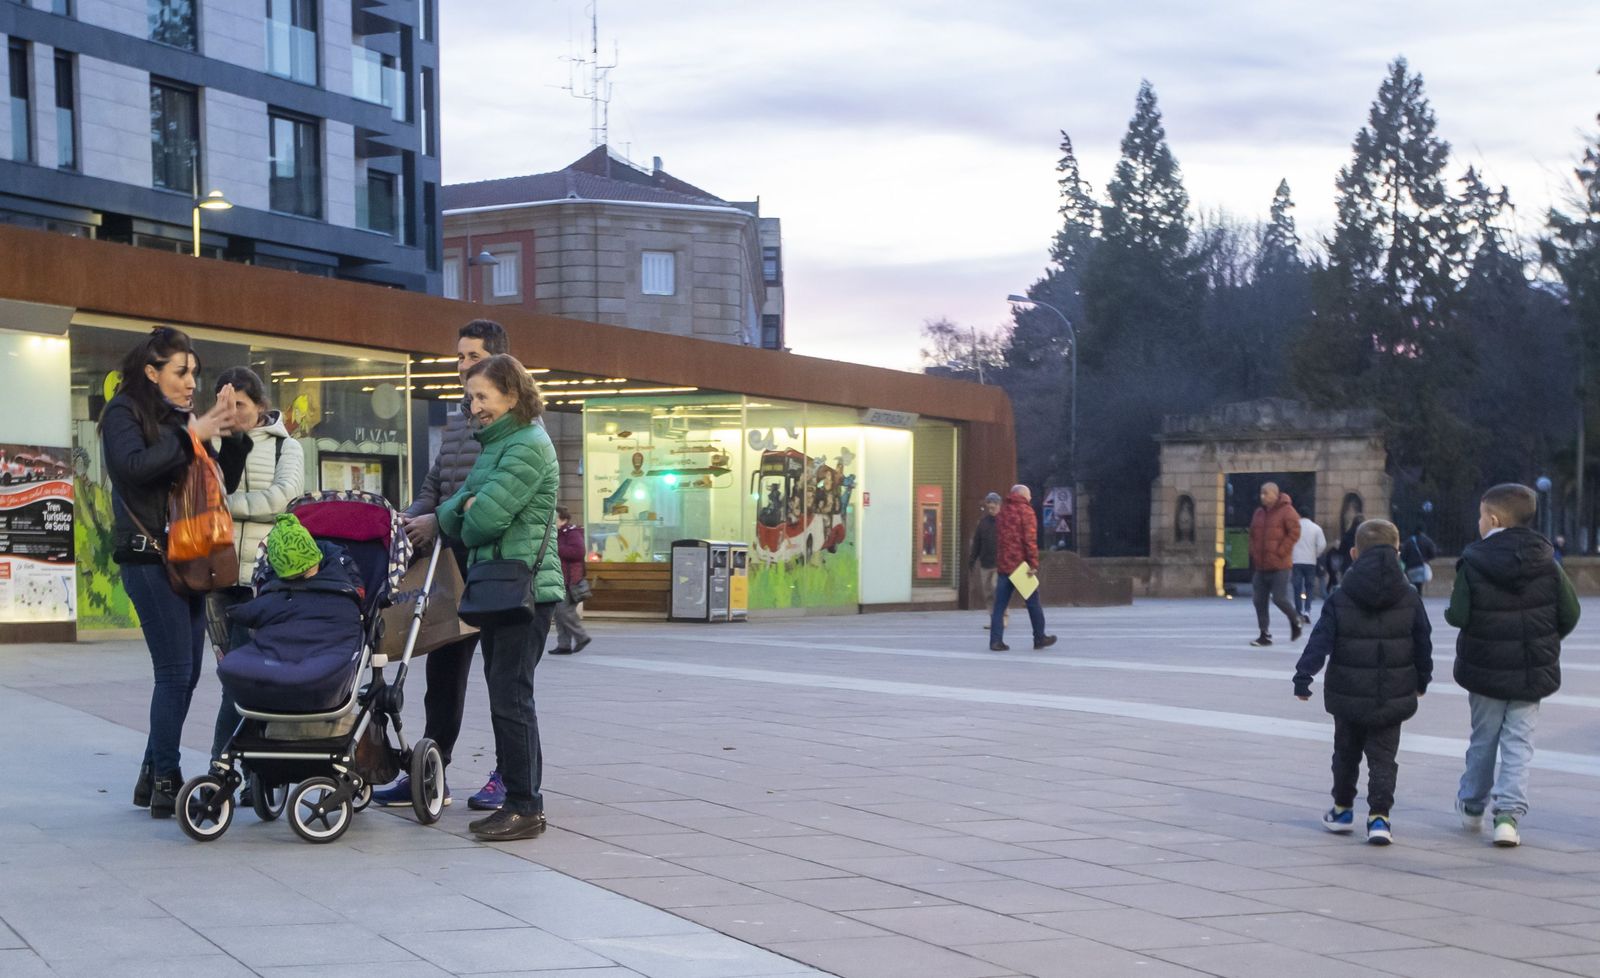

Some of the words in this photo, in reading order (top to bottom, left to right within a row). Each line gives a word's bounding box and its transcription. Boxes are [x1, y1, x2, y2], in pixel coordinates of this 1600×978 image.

[47, 502, 61, 511] Tren
[43, 512, 72, 522] Turístico
[53, 522, 70, 531] Soria
